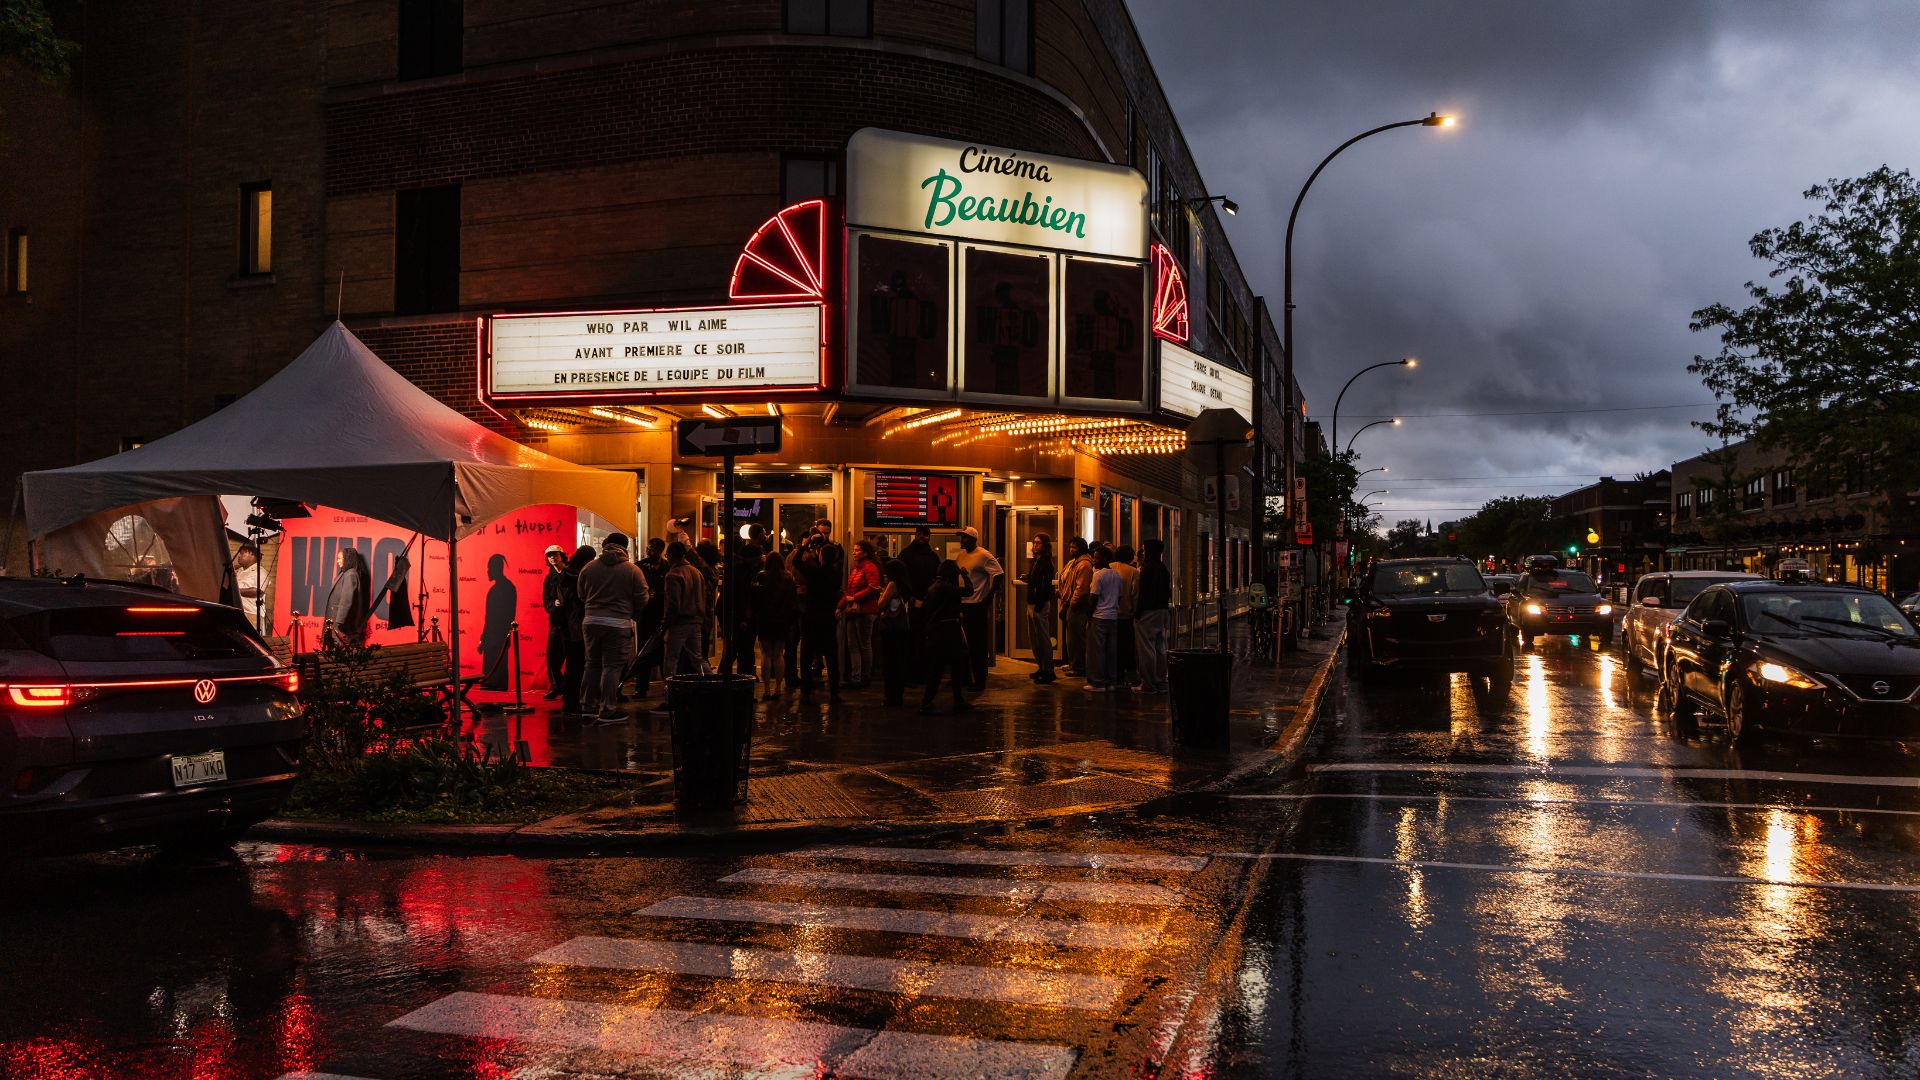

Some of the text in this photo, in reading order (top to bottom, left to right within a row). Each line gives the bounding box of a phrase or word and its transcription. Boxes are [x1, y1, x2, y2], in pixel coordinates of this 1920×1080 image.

[959, 146, 1052, 182] Cinéma
[920, 168, 1086, 239] Beaubien
[586, 318, 728, 334] WHO PAR WIL AIME
[575, 342, 746, 359] AVANT PREMIERE CE SOIR
[554, 373, 568, 384] EN
[570, 371, 630, 383] PRESENCE
[634, 370, 648, 382] DE
[718, 368, 734, 380] DU
[738, 367, 766, 379] FILM
[496, 524, 506, 534] LA
[174, 763, 195, 781] N17
[202, 760, 224, 776] VKQ
